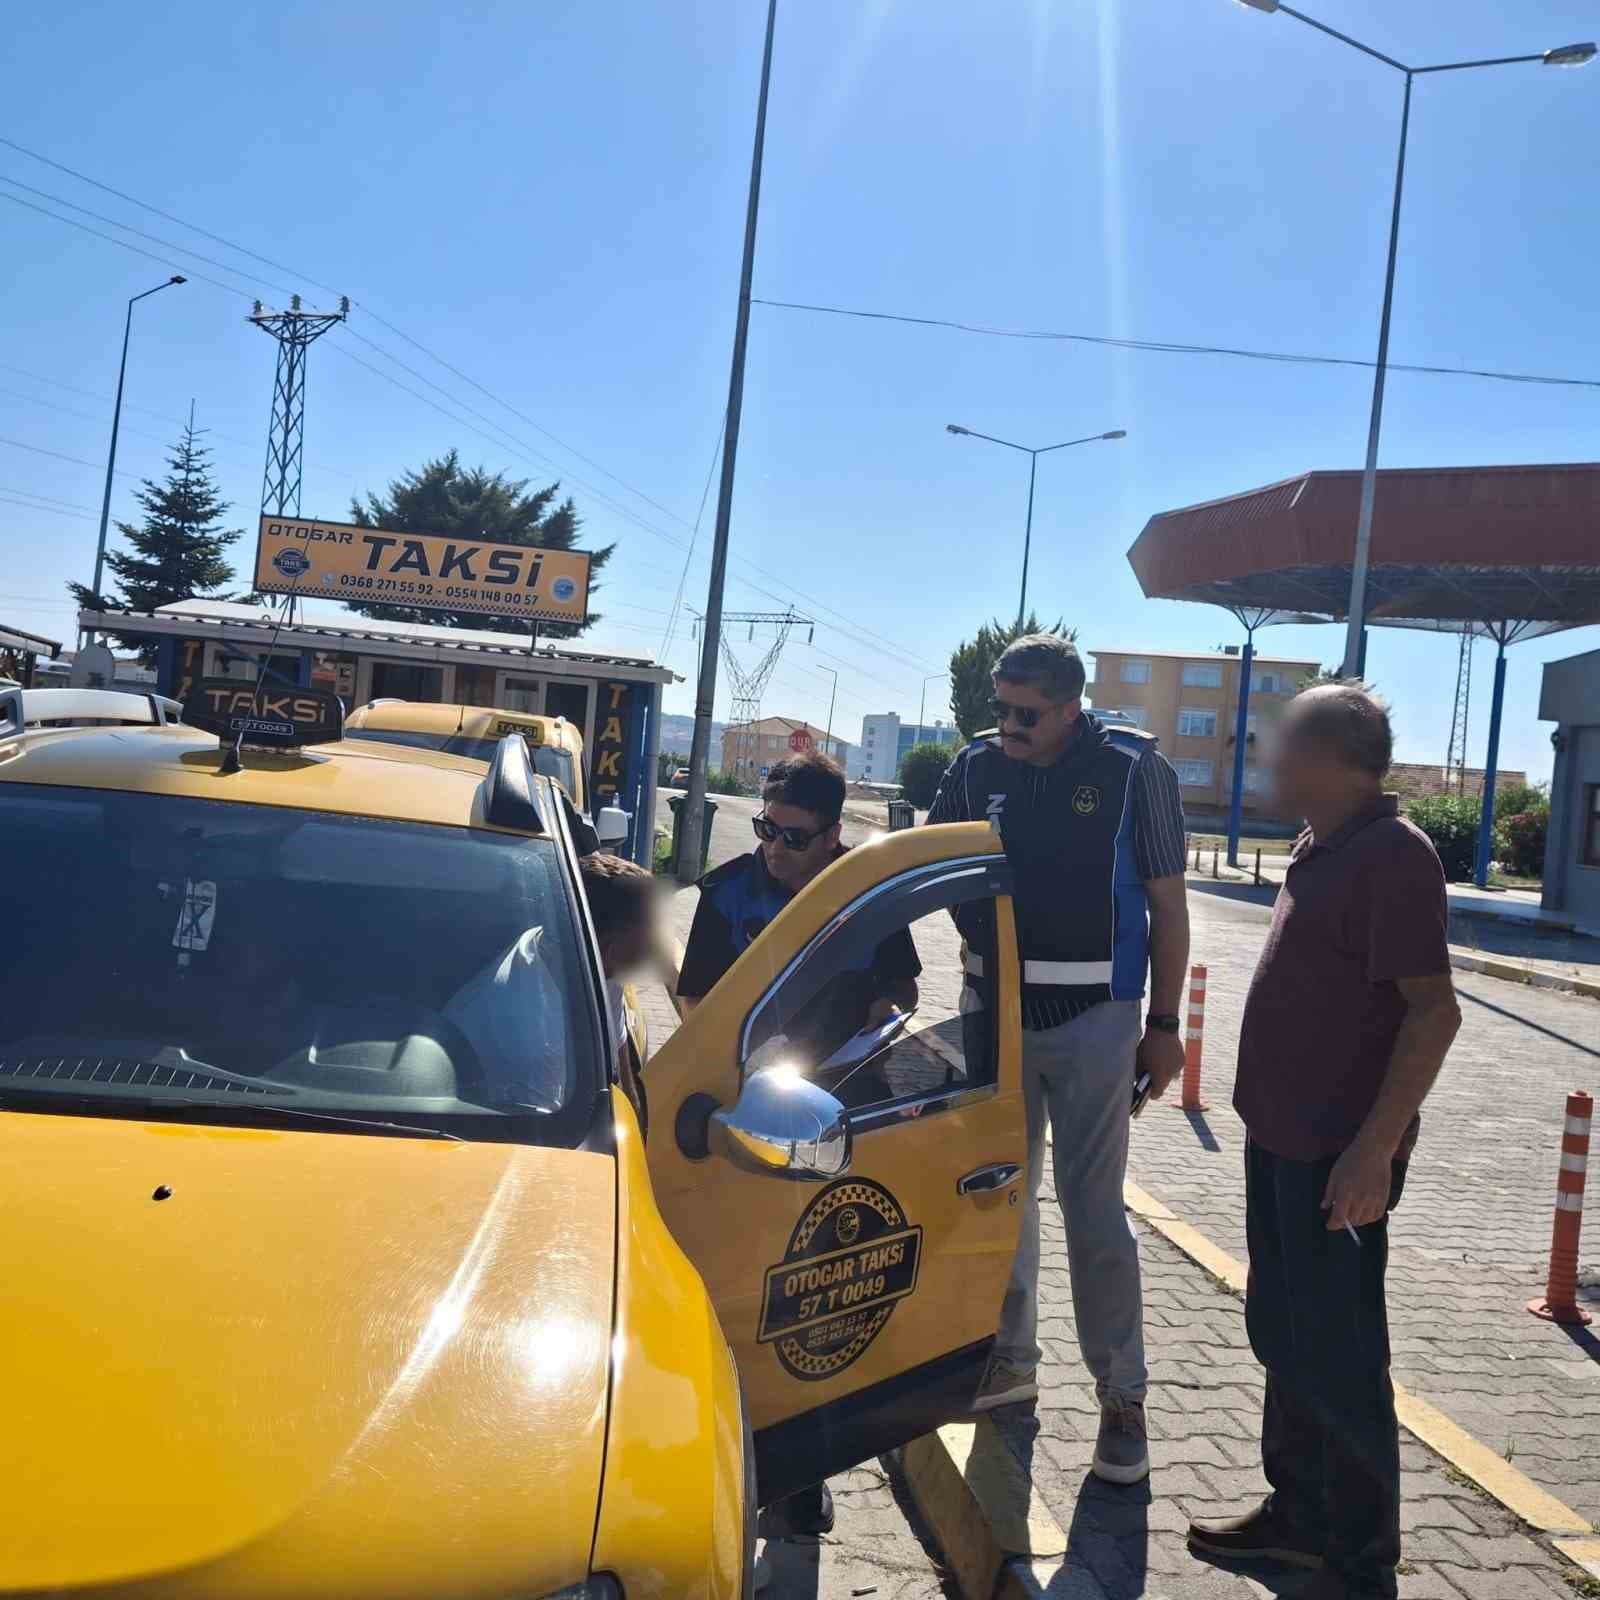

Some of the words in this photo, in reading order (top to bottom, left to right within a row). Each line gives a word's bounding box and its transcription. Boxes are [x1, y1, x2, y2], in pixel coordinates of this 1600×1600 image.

[268, 523, 353, 544] OTOGAR
[340, 574, 373, 588] 0368
[377, 579, 397, 590] 271
[400, 581, 415, 593] 55
[417, 583, 433, 595] 92
[446, 586, 477, 600] 0554
[479, 590, 500, 602] 148
[505, 592, 521, 604] 00
[525, 594, 539, 606] 57
[784, 1261, 854, 1297] OTOGAR
[798, 1294, 822, 1319] 57
[827, 1290, 840, 1311] T
[843, 1274, 885, 1305] 0049
